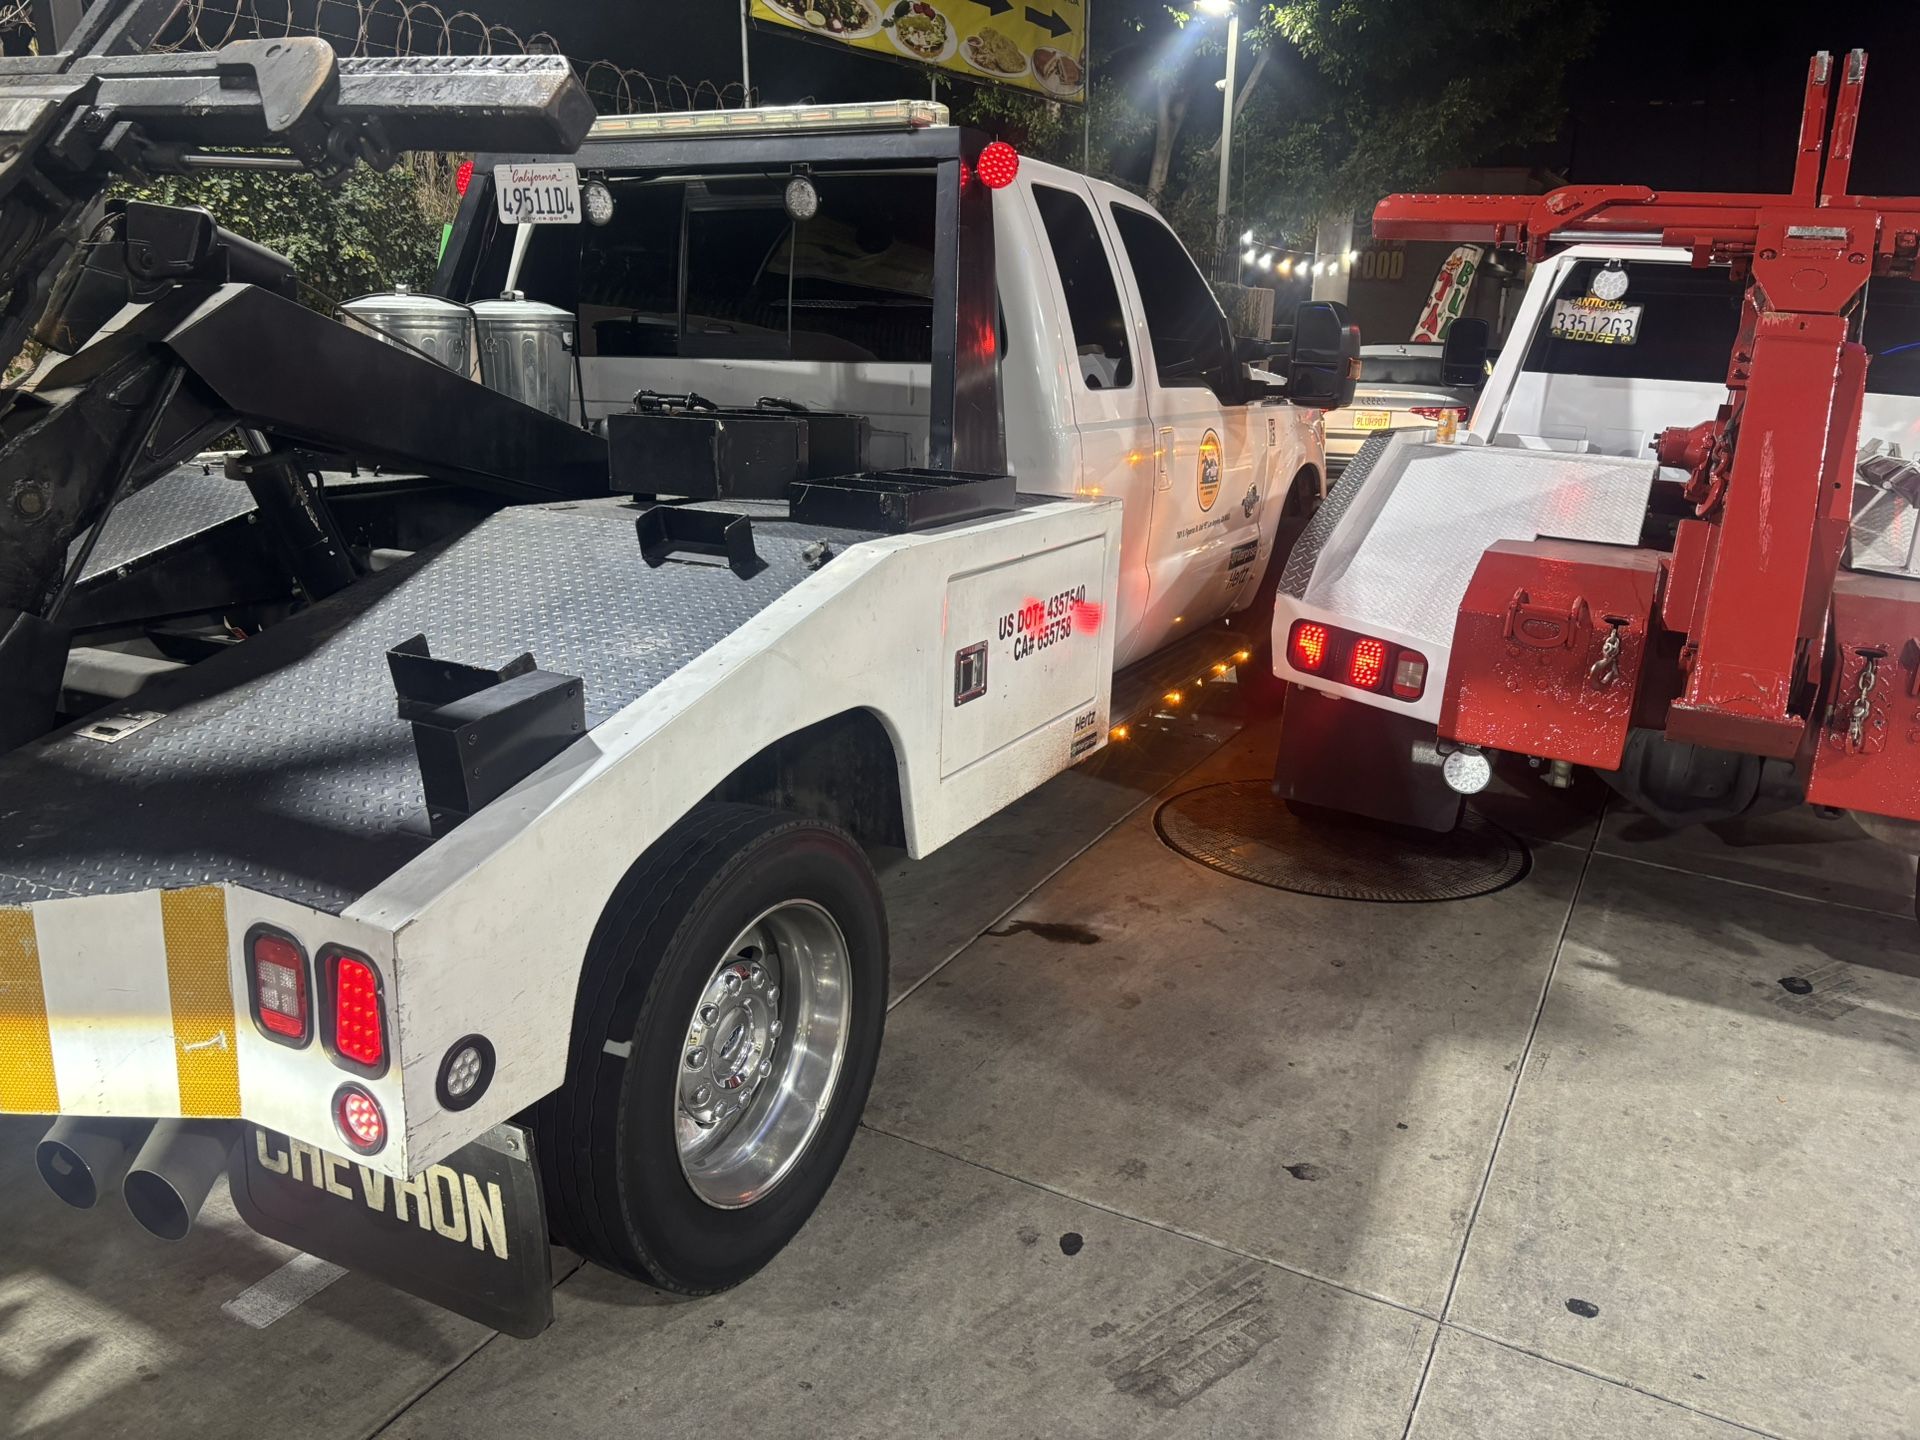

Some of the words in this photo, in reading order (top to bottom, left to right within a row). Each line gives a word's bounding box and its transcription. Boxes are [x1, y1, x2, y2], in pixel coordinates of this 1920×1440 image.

[512, 169, 562, 186] California
[503, 187, 575, 215] 49511D4
[1574, 296, 1624, 310] ANTIOCH
[1556, 312, 1634, 337] 33512G3
[1565, 329, 1615, 344] DODGE
[999, 613, 1014, 641] US
[1017, 600, 1045, 634] DOT#
[1047, 584, 1086, 620] 4357540
[1014, 631, 1035, 661] CA#
[1037, 615, 1072, 651] 655758
[1074, 710, 1096, 733] Hertz
[256, 1129, 508, 1261] CHEVRON
